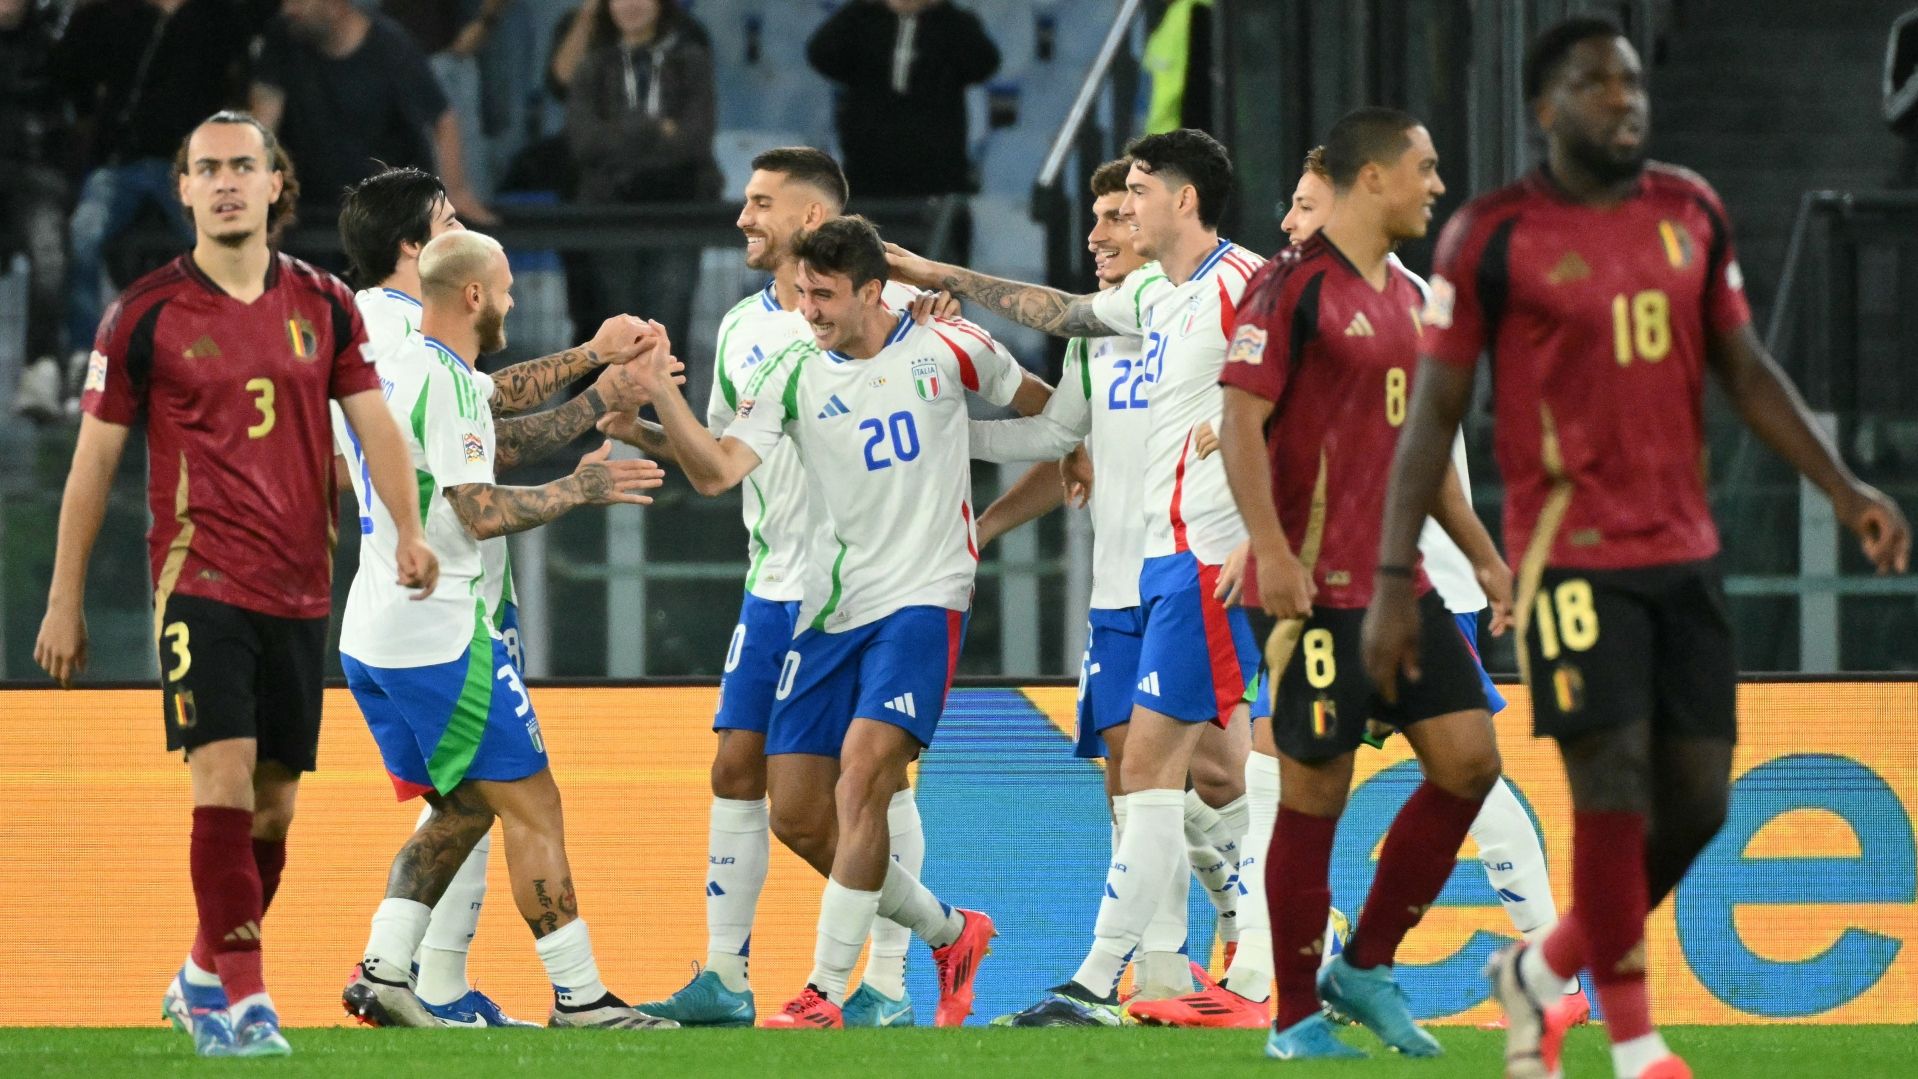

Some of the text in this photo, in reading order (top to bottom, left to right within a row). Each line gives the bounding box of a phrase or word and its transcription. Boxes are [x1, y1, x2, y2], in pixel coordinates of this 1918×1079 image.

[1145, 331, 1169, 384] 21
[1612, 288, 1671, 367] 18
[913, 366, 935, 376] ITALIA
[1108, 358, 1149, 410] 22
[1386, 366, 1407, 427] 8
[245, 377, 276, 439] 3
[859, 410, 920, 471] 20
[1536, 577, 1599, 661] 18
[165, 621, 192, 682] 3
[775, 650, 801, 701] 0
[1303, 628, 1336, 689] 8
[496, 664, 529, 718] 3
